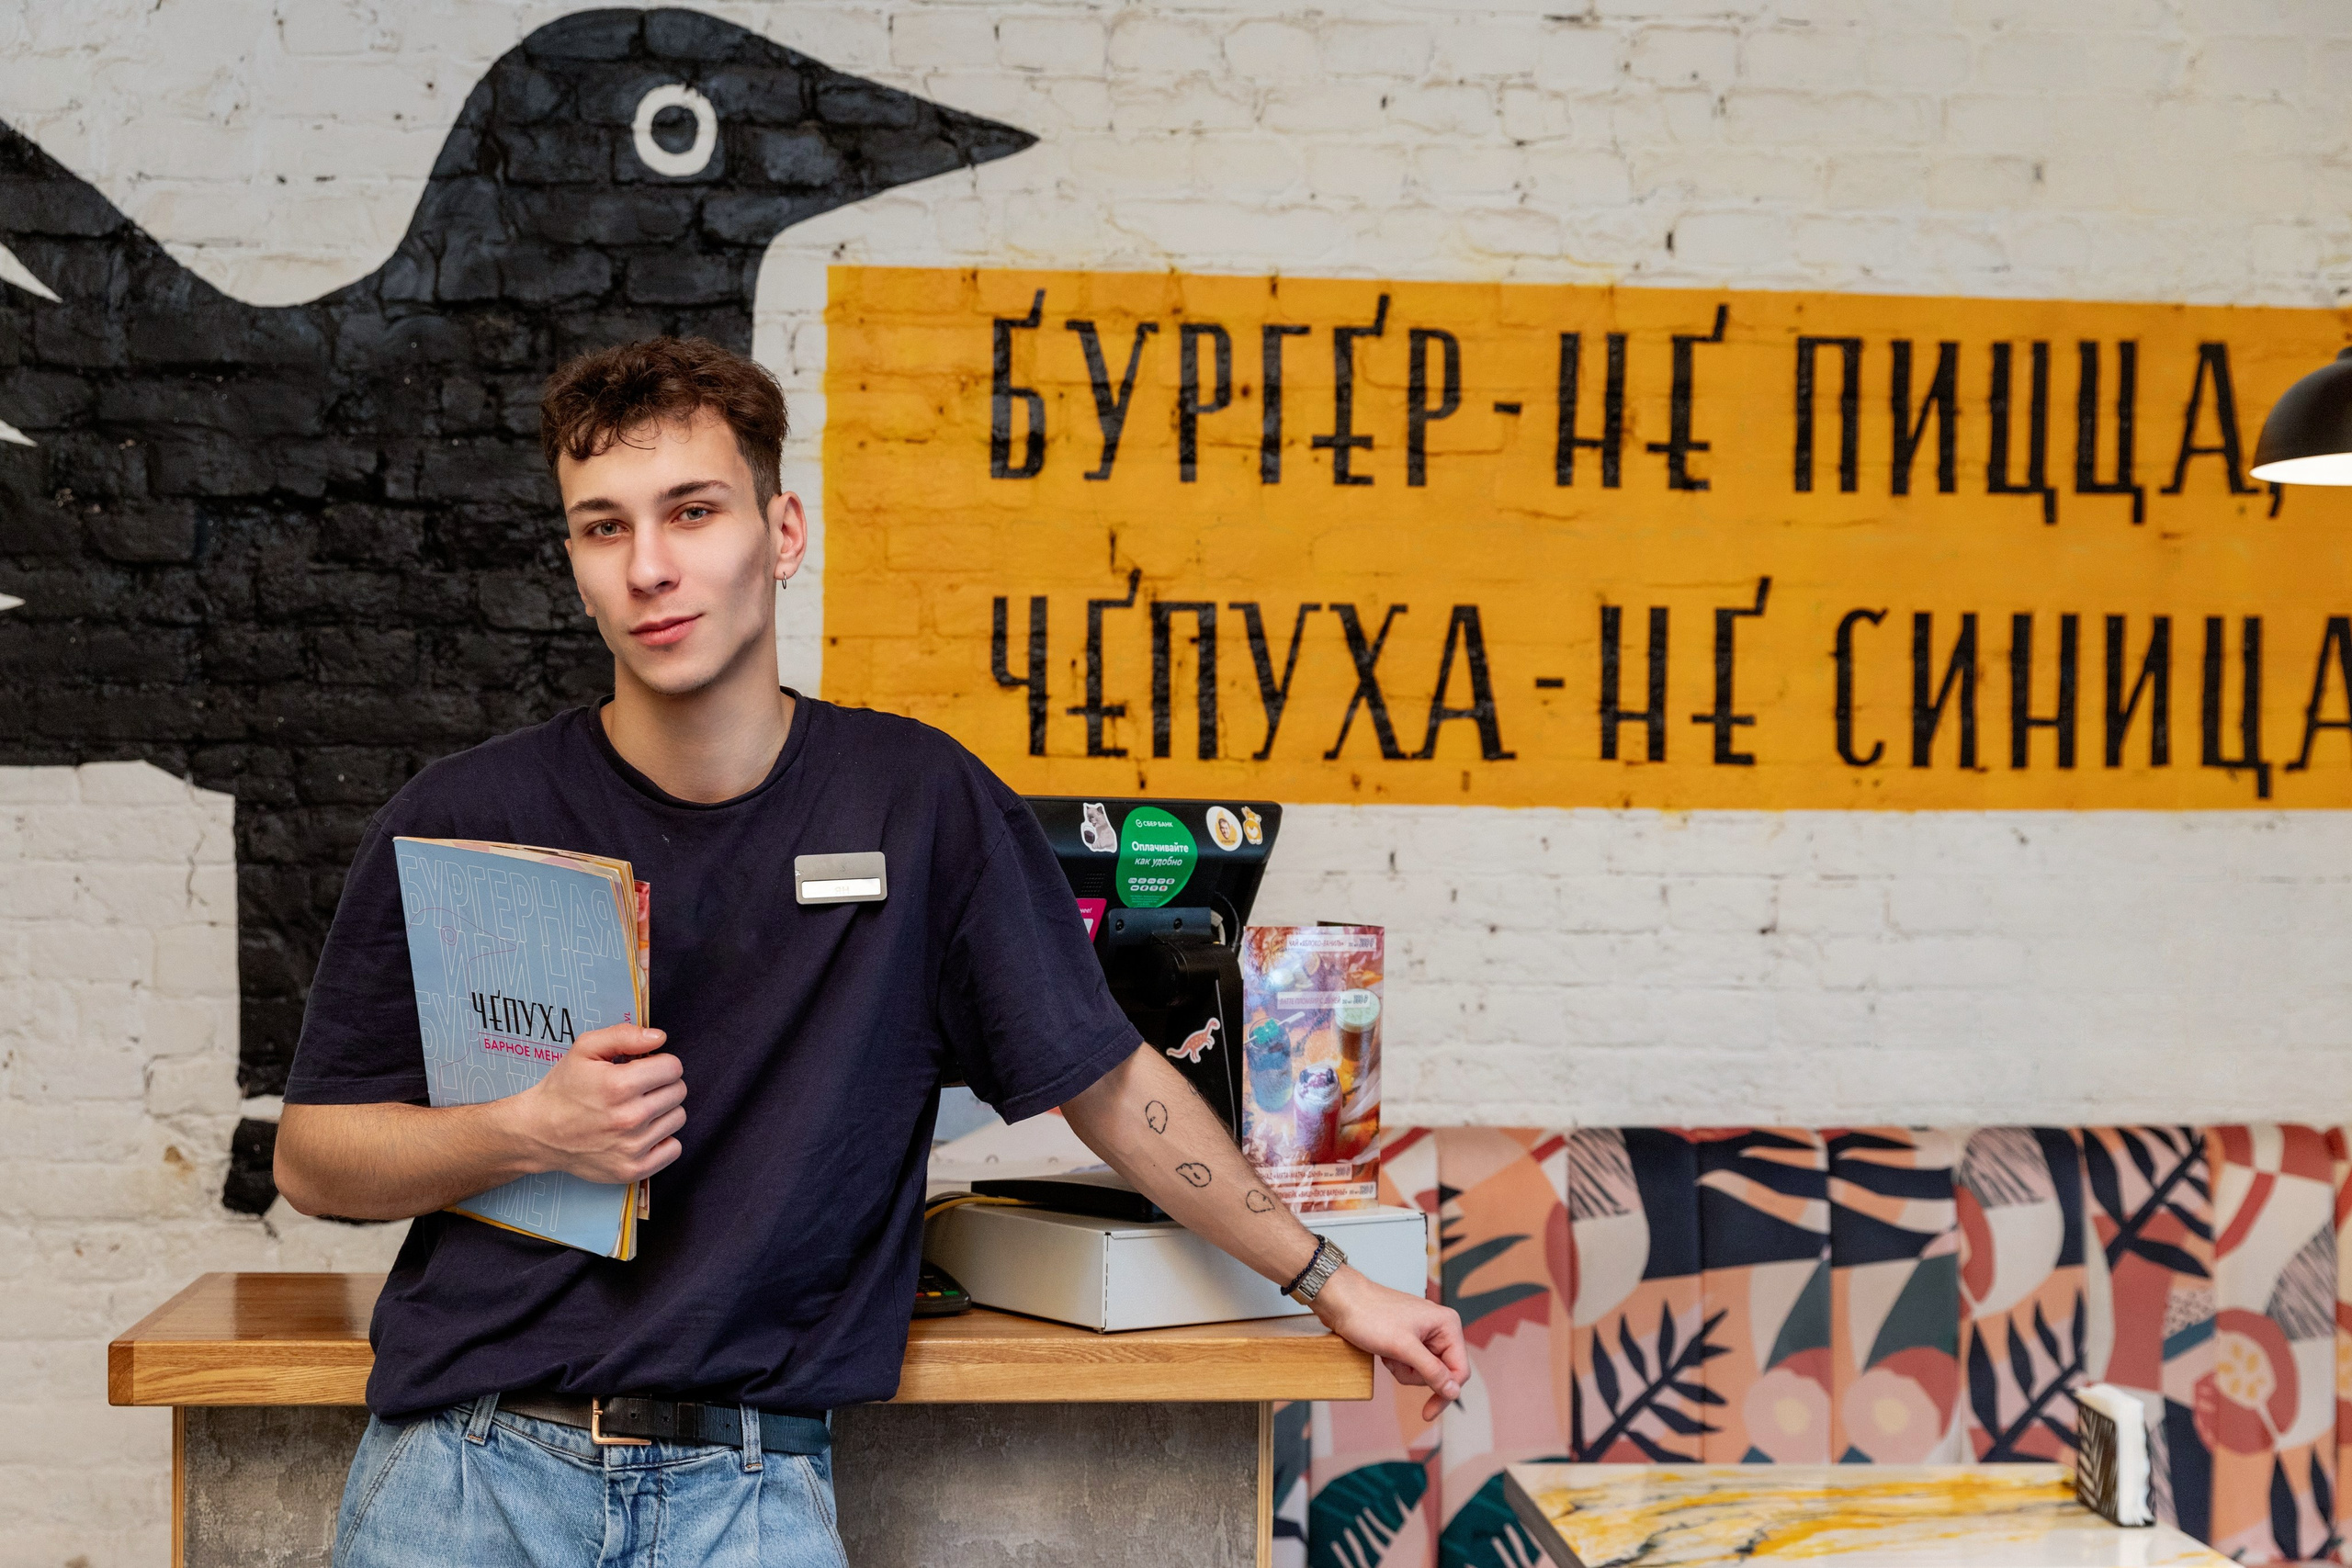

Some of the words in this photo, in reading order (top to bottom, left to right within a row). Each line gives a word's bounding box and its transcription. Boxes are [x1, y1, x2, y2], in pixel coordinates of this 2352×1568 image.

[1831, 606, 2352, 799] СИНИЦА
[1131, 840, 1189, 853] Оплачивайте
[1135, 857, 1151, 865] как
[1151, 856, 1182, 867] удобно
[399, 854, 621, 960] БУРГЕРНАЯ
[441, 929, 534, 1007] ИЛИ
[542, 944, 602, 1023] НЕ
[471, 989, 576, 1044] ЧЕПУХА
[483, 1038, 530, 1057] БАРНОЕ
[534, 1047, 564, 1062] МЕН
